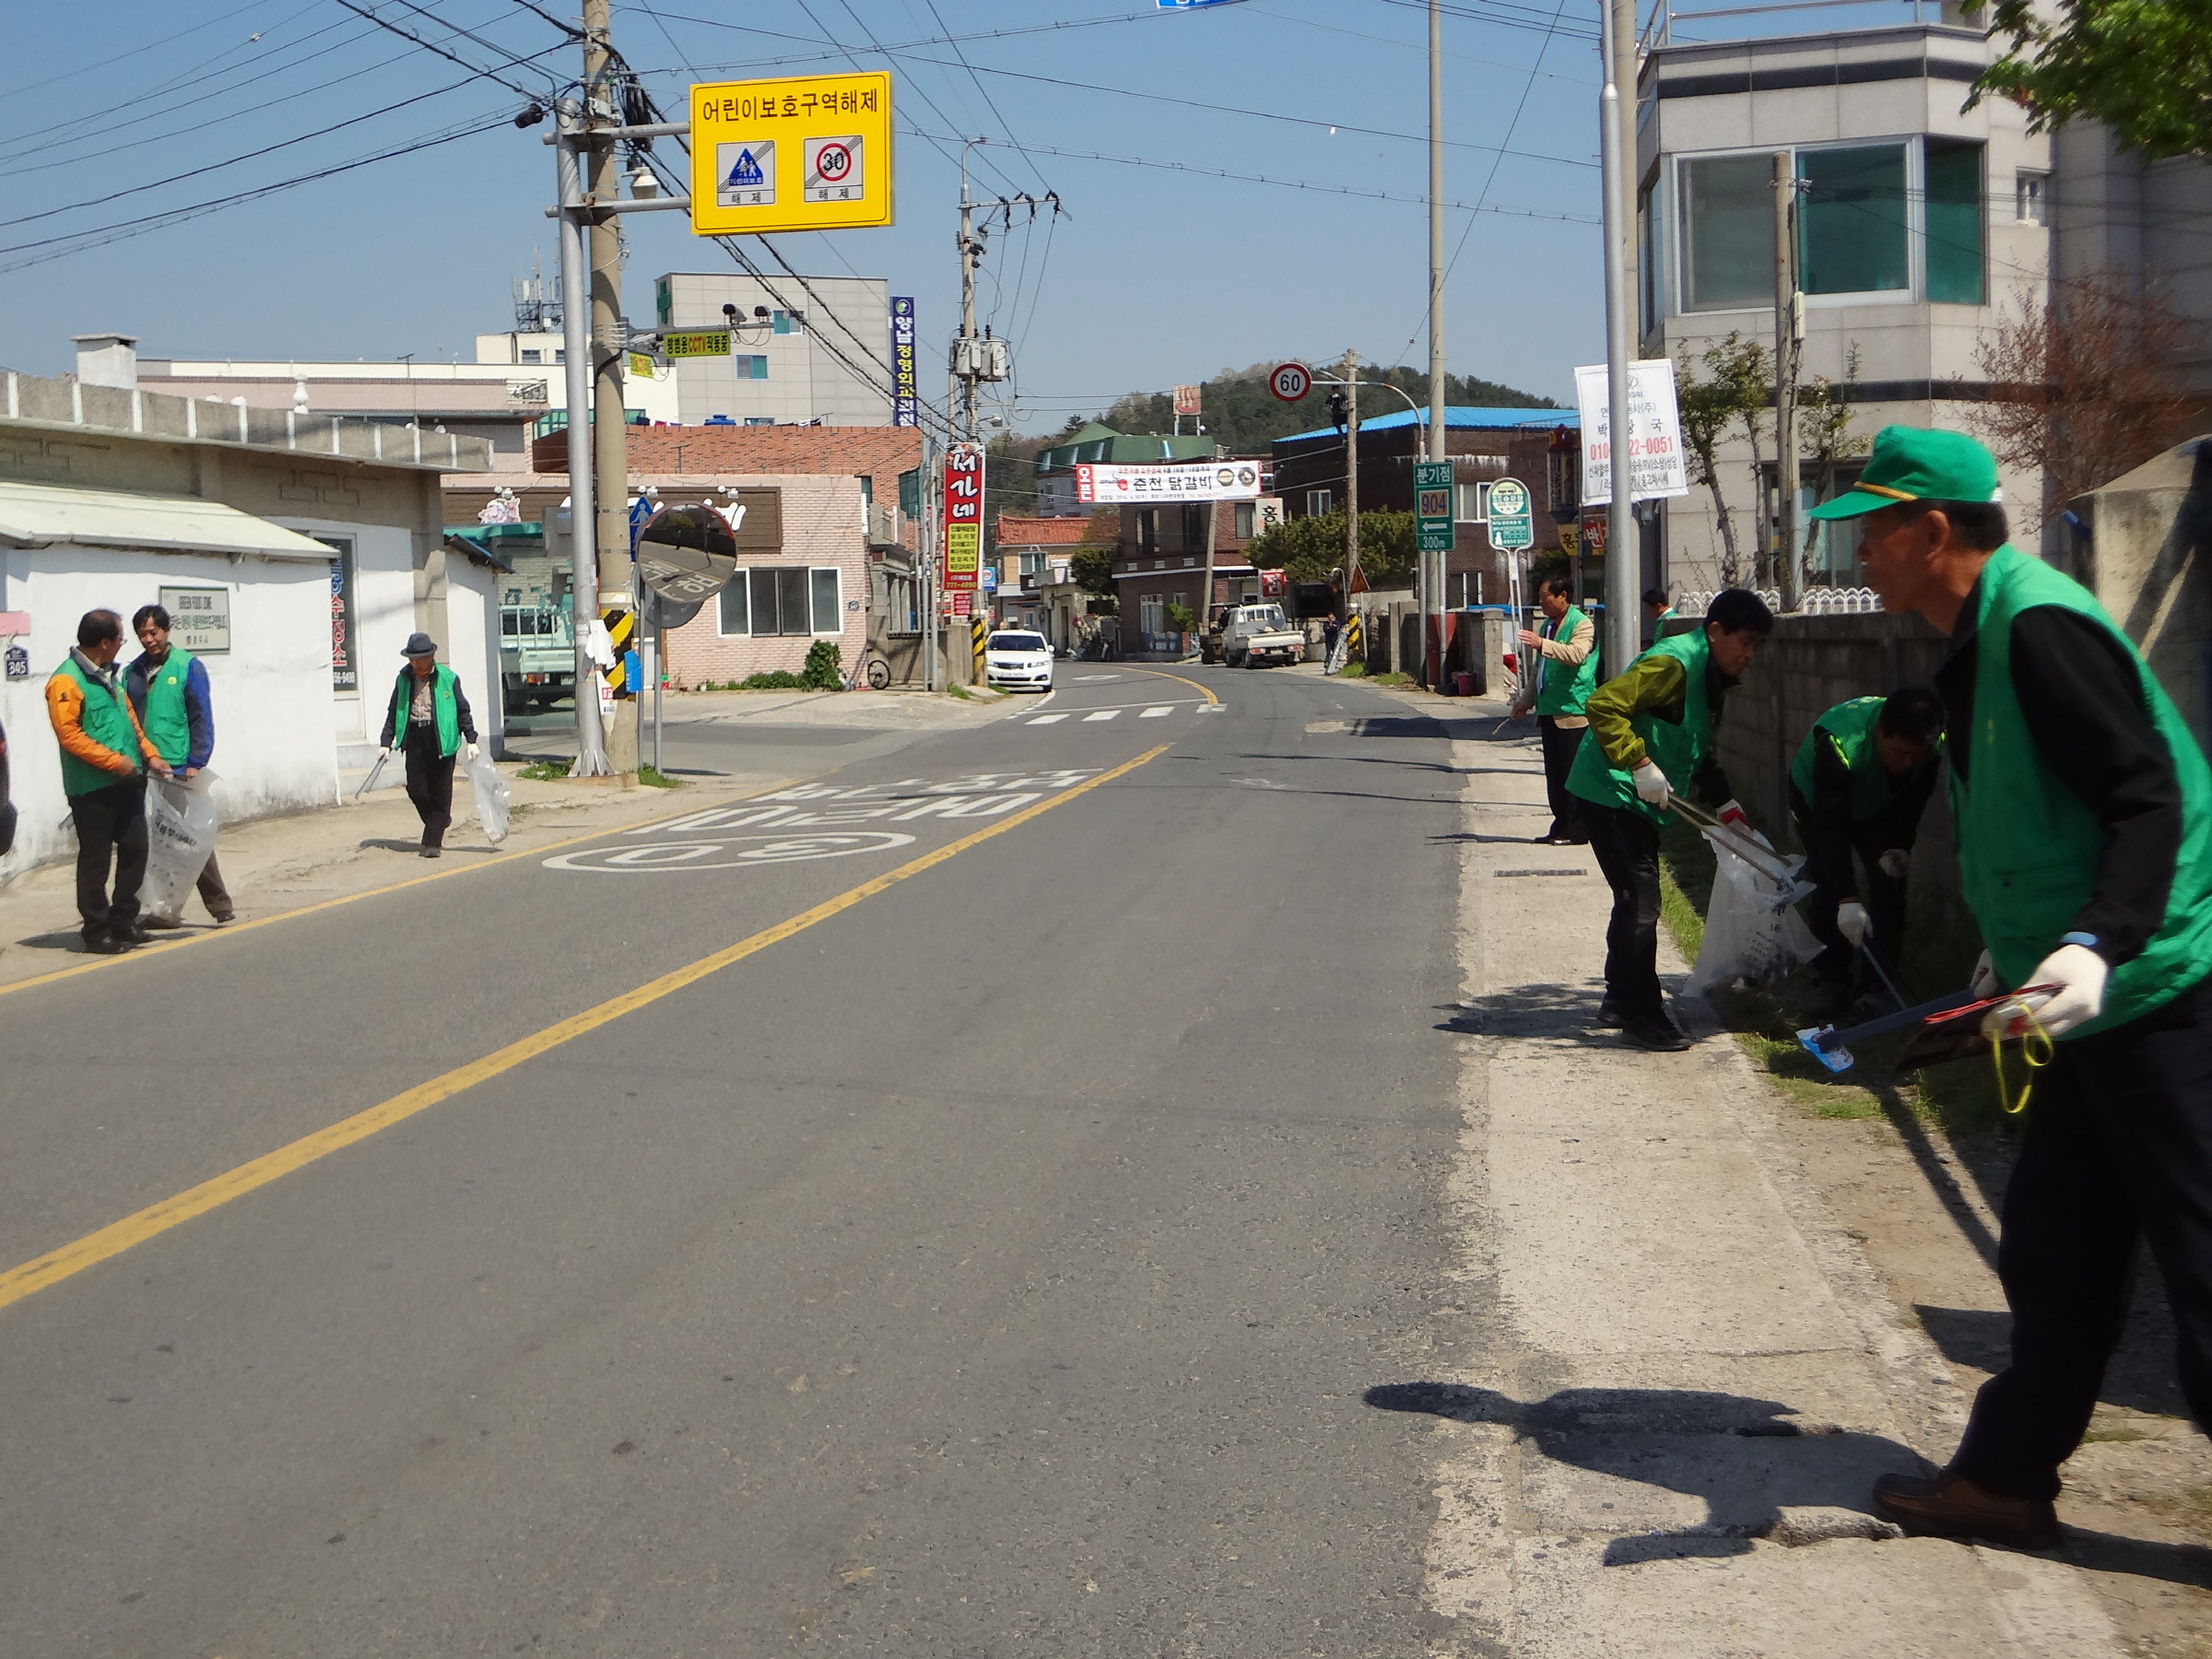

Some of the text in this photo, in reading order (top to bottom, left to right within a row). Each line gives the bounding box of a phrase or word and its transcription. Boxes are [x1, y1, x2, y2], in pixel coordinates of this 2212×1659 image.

[702, 88, 878, 123] 어린이보호구역해제
[822, 151, 845, 172] 30
[1280, 373, 1300, 393] 60
[1133, 476, 1164, 492] 춘천
[1168, 475, 1213, 491] 닭갈비
[1417, 465, 1451, 484] 분기점
[1420, 492, 1447, 514] 904
[1422, 535, 1446, 548] 300m
[621, 792, 1042, 836] 어린이
[603, 836, 862, 865] 30
